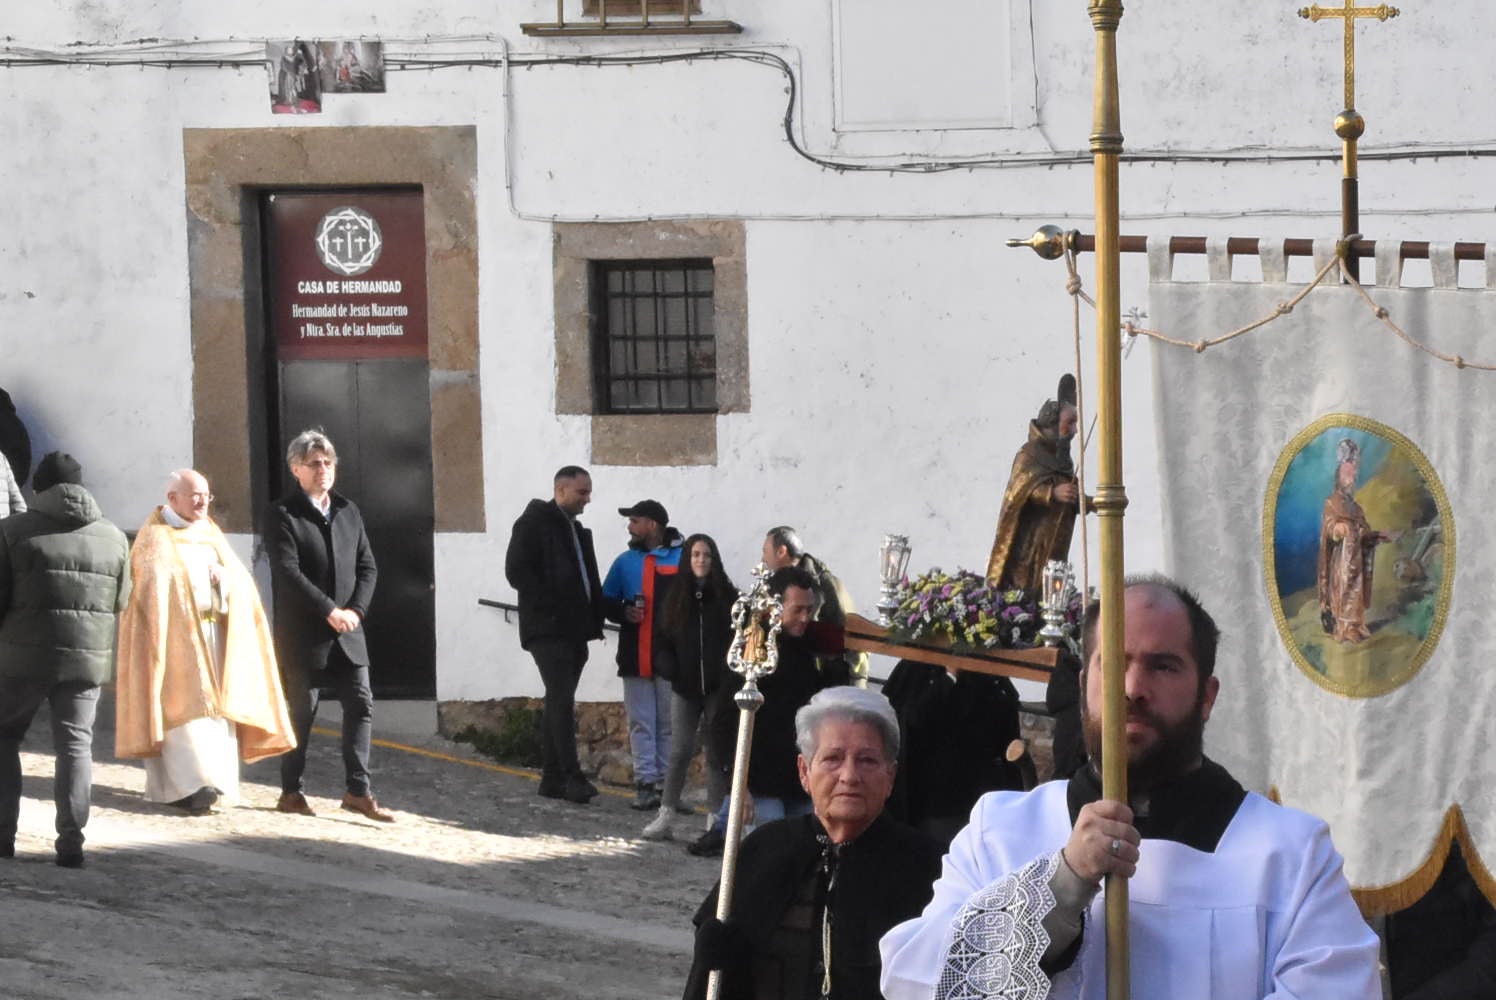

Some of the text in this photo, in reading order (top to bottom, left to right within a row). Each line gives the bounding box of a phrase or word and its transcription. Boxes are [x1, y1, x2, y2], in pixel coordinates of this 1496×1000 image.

[297, 280, 402, 294] CASA DE HERMANDAD
[292, 303, 408, 318] Hermandad de Jesús Nazareno
[300, 322, 404, 339] y Ntra. Sra. de las Angustias
